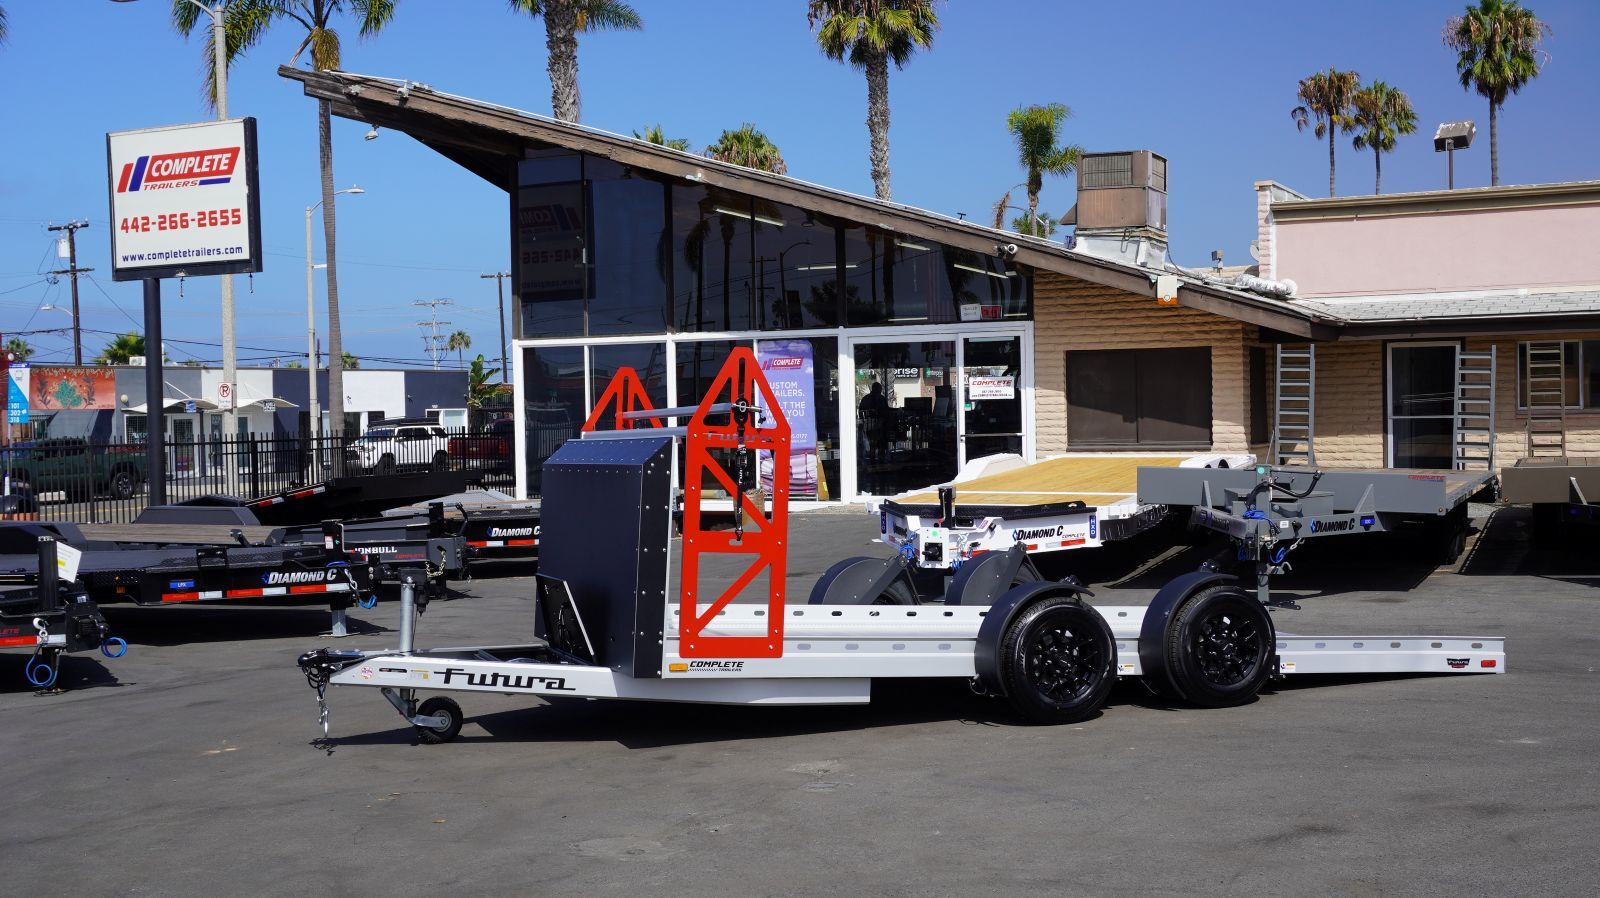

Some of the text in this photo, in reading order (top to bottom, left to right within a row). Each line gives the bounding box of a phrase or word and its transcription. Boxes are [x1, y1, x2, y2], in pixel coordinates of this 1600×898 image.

[151, 153, 232, 177] COMPLETE
[143, 180, 199, 191] TRAILERS
[120, 208, 241, 234] 442-266-2655
[121, 246, 243, 262] www.completetrailers.com
[773, 358, 801, 366] COMPLETE
[769, 381, 798, 390] USTOM
[773, 389, 805, 397] AILERS.
[790, 401, 806, 409] THE
[787, 409, 805, 417] YOU
[491, 525, 541, 537] DIAMOND C
[1315, 518, 1356, 532] DIAMOND C
[1016, 525, 1064, 541] DIAMOND C
[268, 569, 337, 585] DIAMOND C
[690, 660, 745, 668] COMPLETE
[433, 668, 577, 692] Futura
